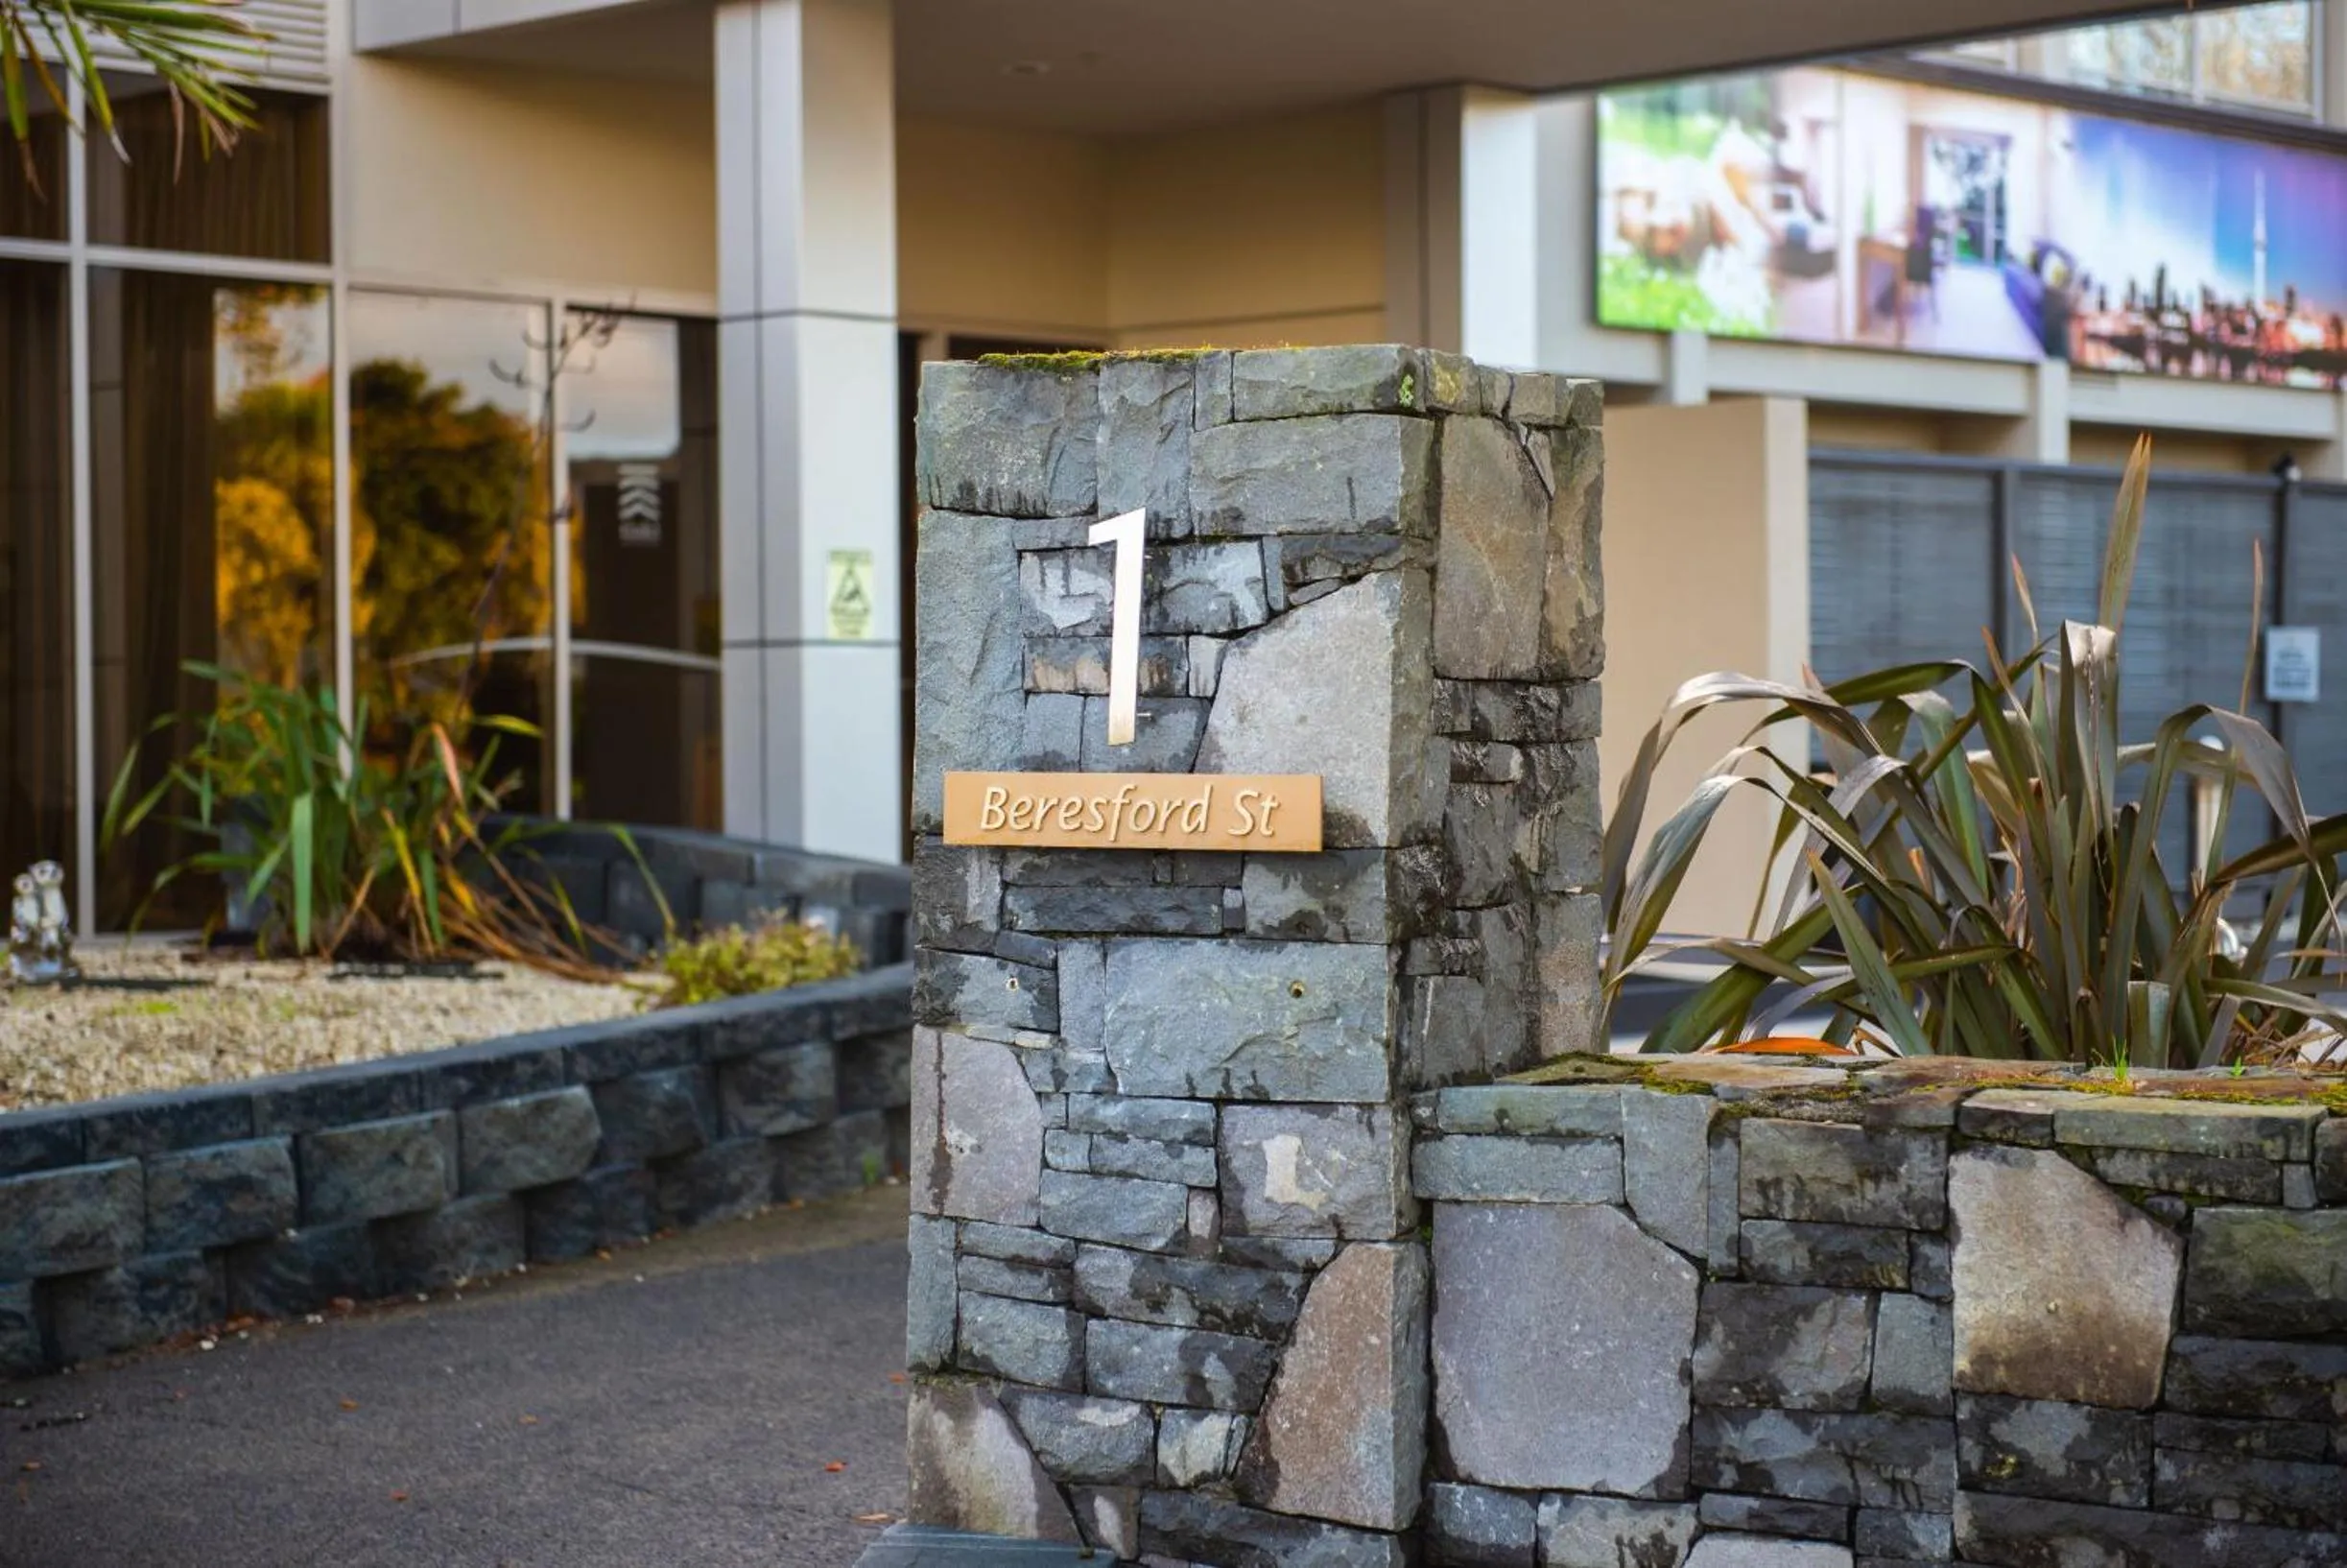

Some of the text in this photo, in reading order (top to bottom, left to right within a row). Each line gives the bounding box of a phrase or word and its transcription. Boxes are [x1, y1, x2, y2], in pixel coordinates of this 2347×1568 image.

[1088, 507, 1147, 746] 1
[980, 783, 1281, 843] Beresford St
